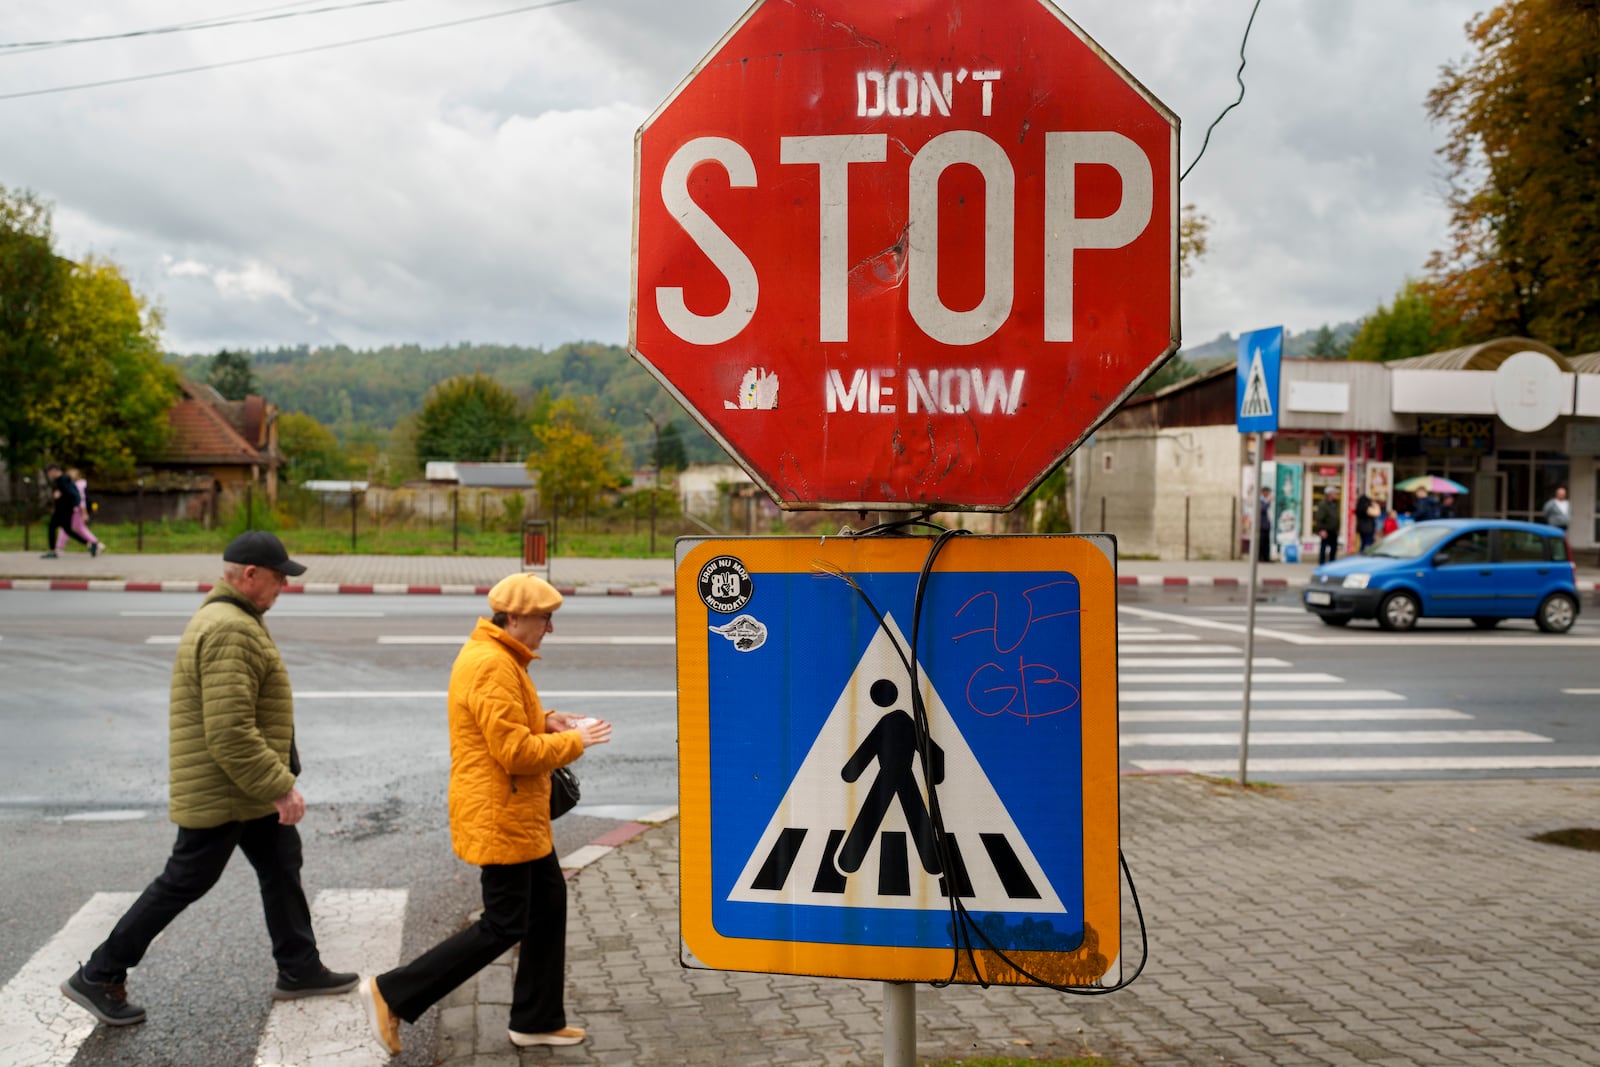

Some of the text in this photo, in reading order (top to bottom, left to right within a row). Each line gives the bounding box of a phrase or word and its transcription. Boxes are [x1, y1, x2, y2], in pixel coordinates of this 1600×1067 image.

[856, 70, 1002, 118] DON'T
[655, 130, 1155, 346] STOP
[825, 367, 1027, 416] ME NOW
[1420, 419, 1492, 438] XEROX
[701, 559, 748, 583] EROII NU MOR
[705, 595, 747, 611] NICIODATA
